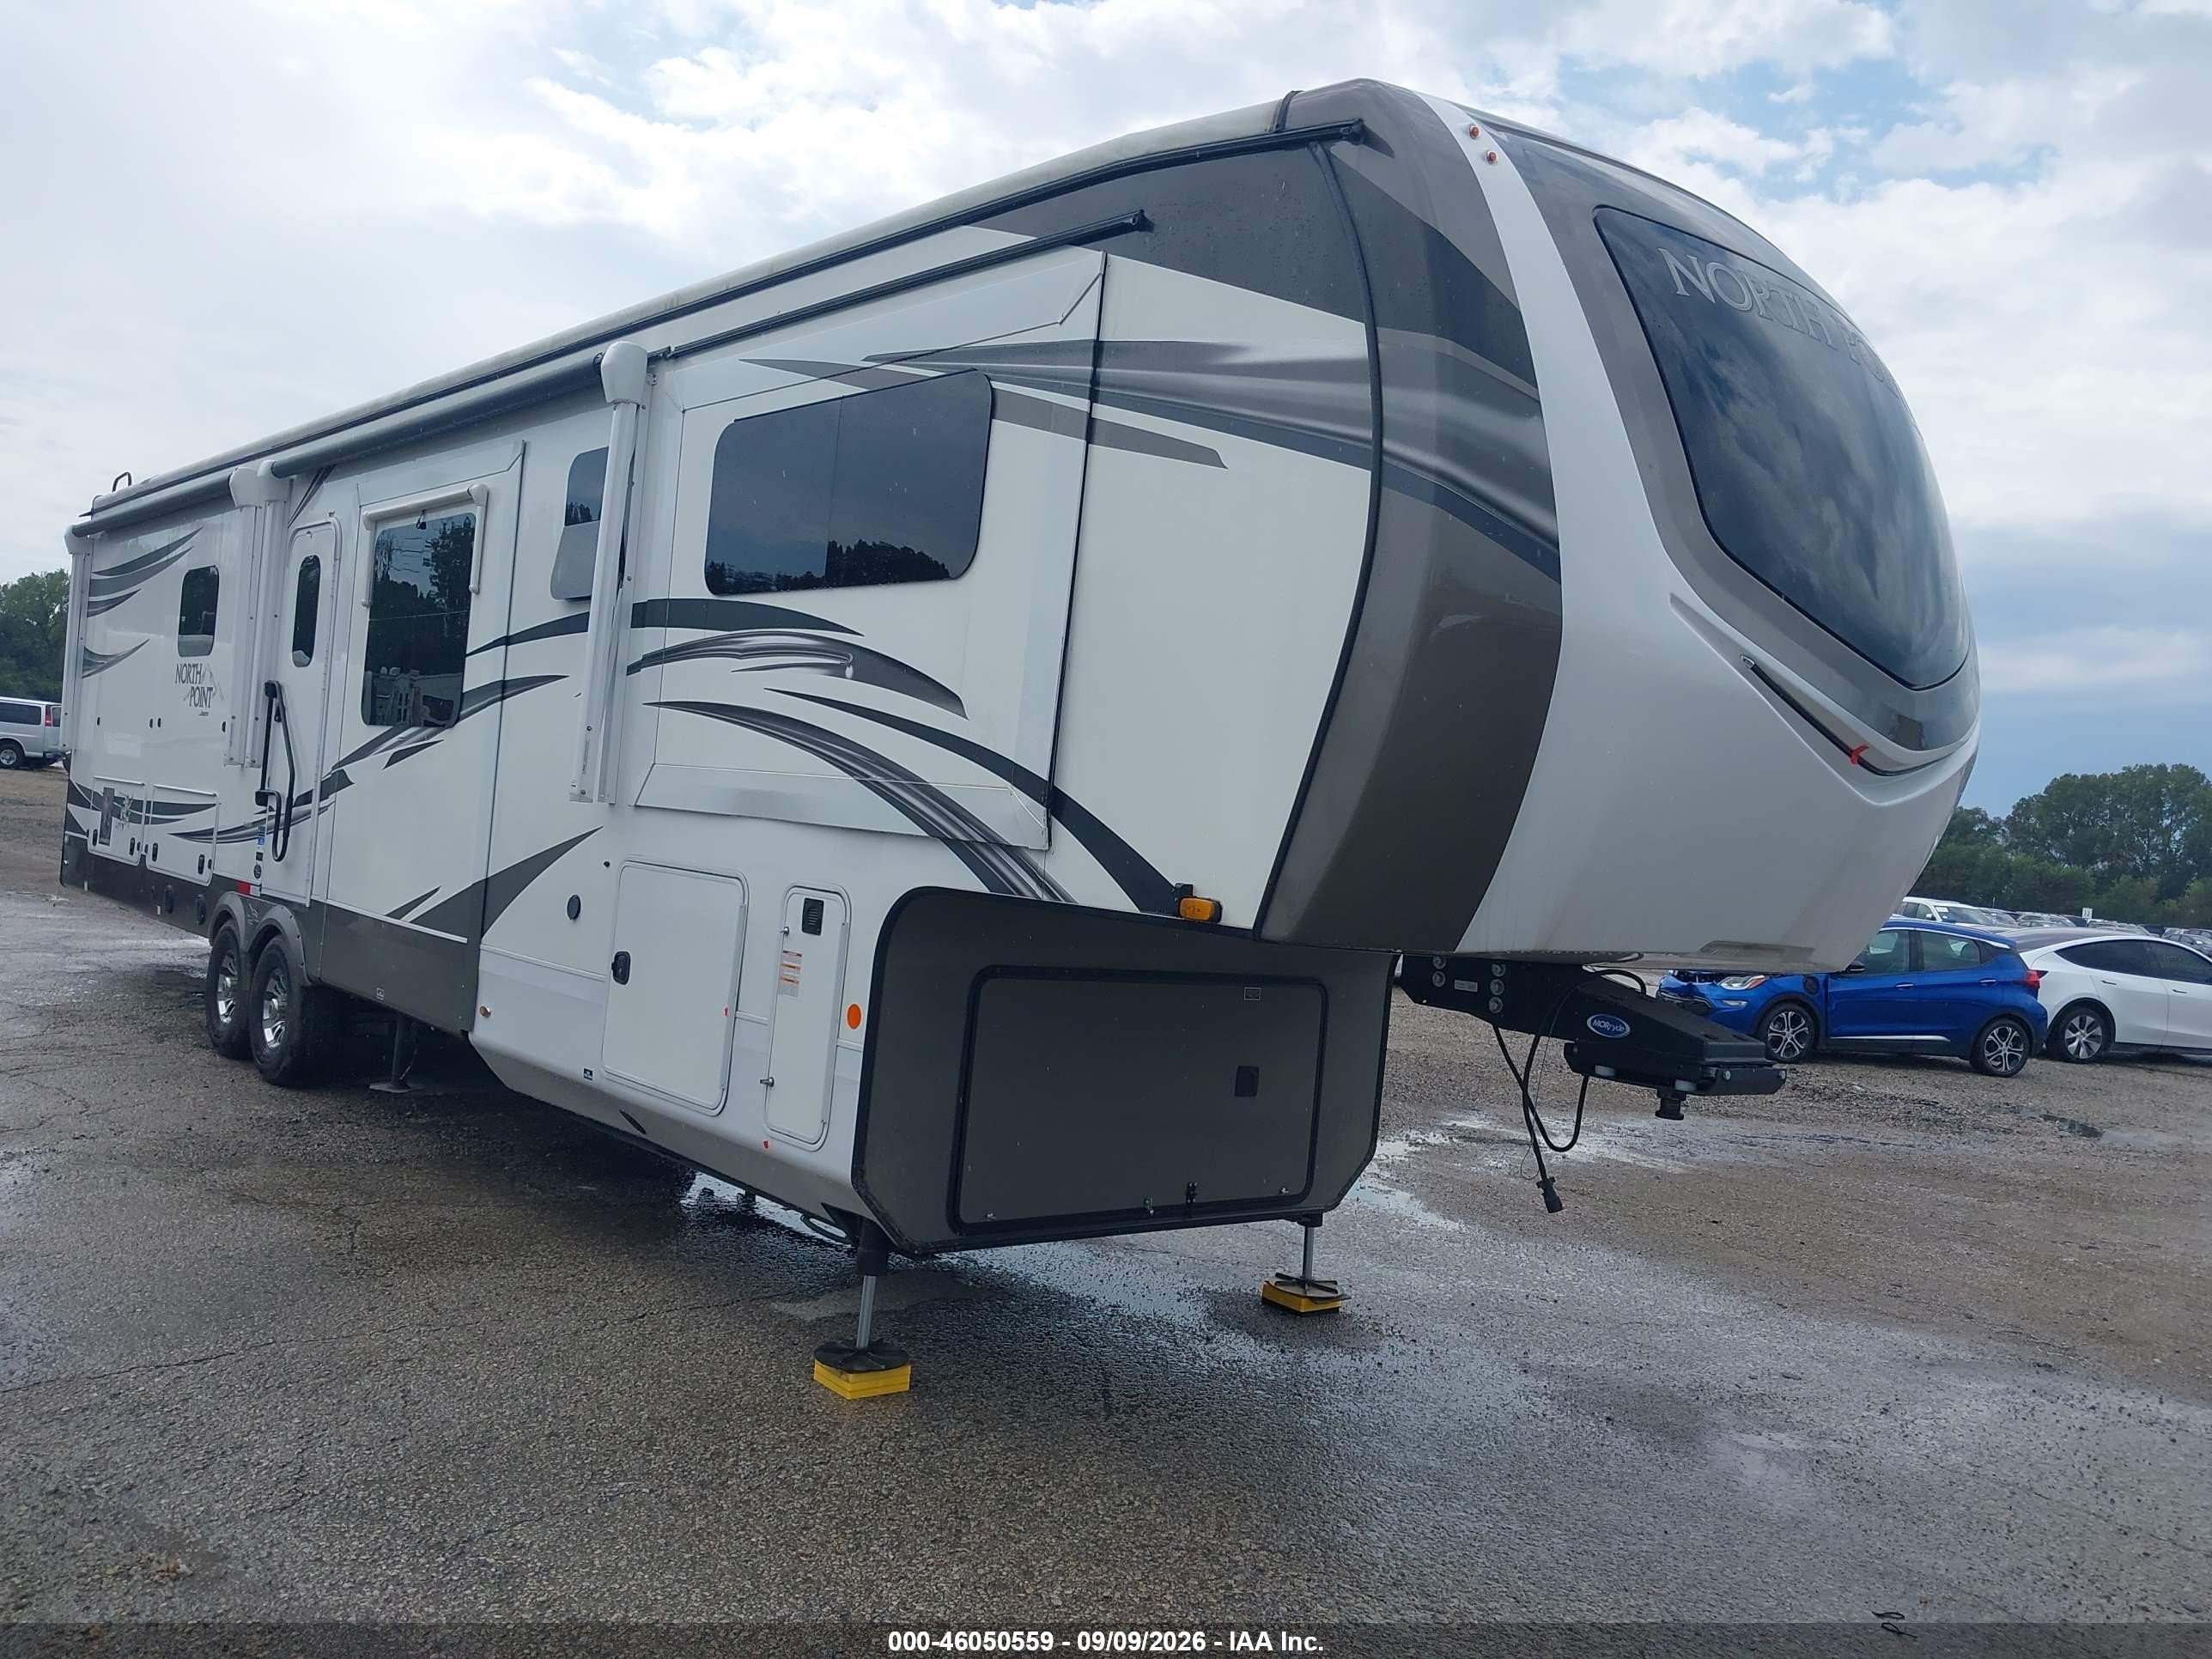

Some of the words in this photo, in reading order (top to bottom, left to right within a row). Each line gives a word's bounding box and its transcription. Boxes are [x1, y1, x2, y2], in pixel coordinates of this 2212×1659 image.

[1657, 247, 1838, 350] NORTH
[175, 663, 203, 684] NORTH
[189, 685, 213, 708] POINT
